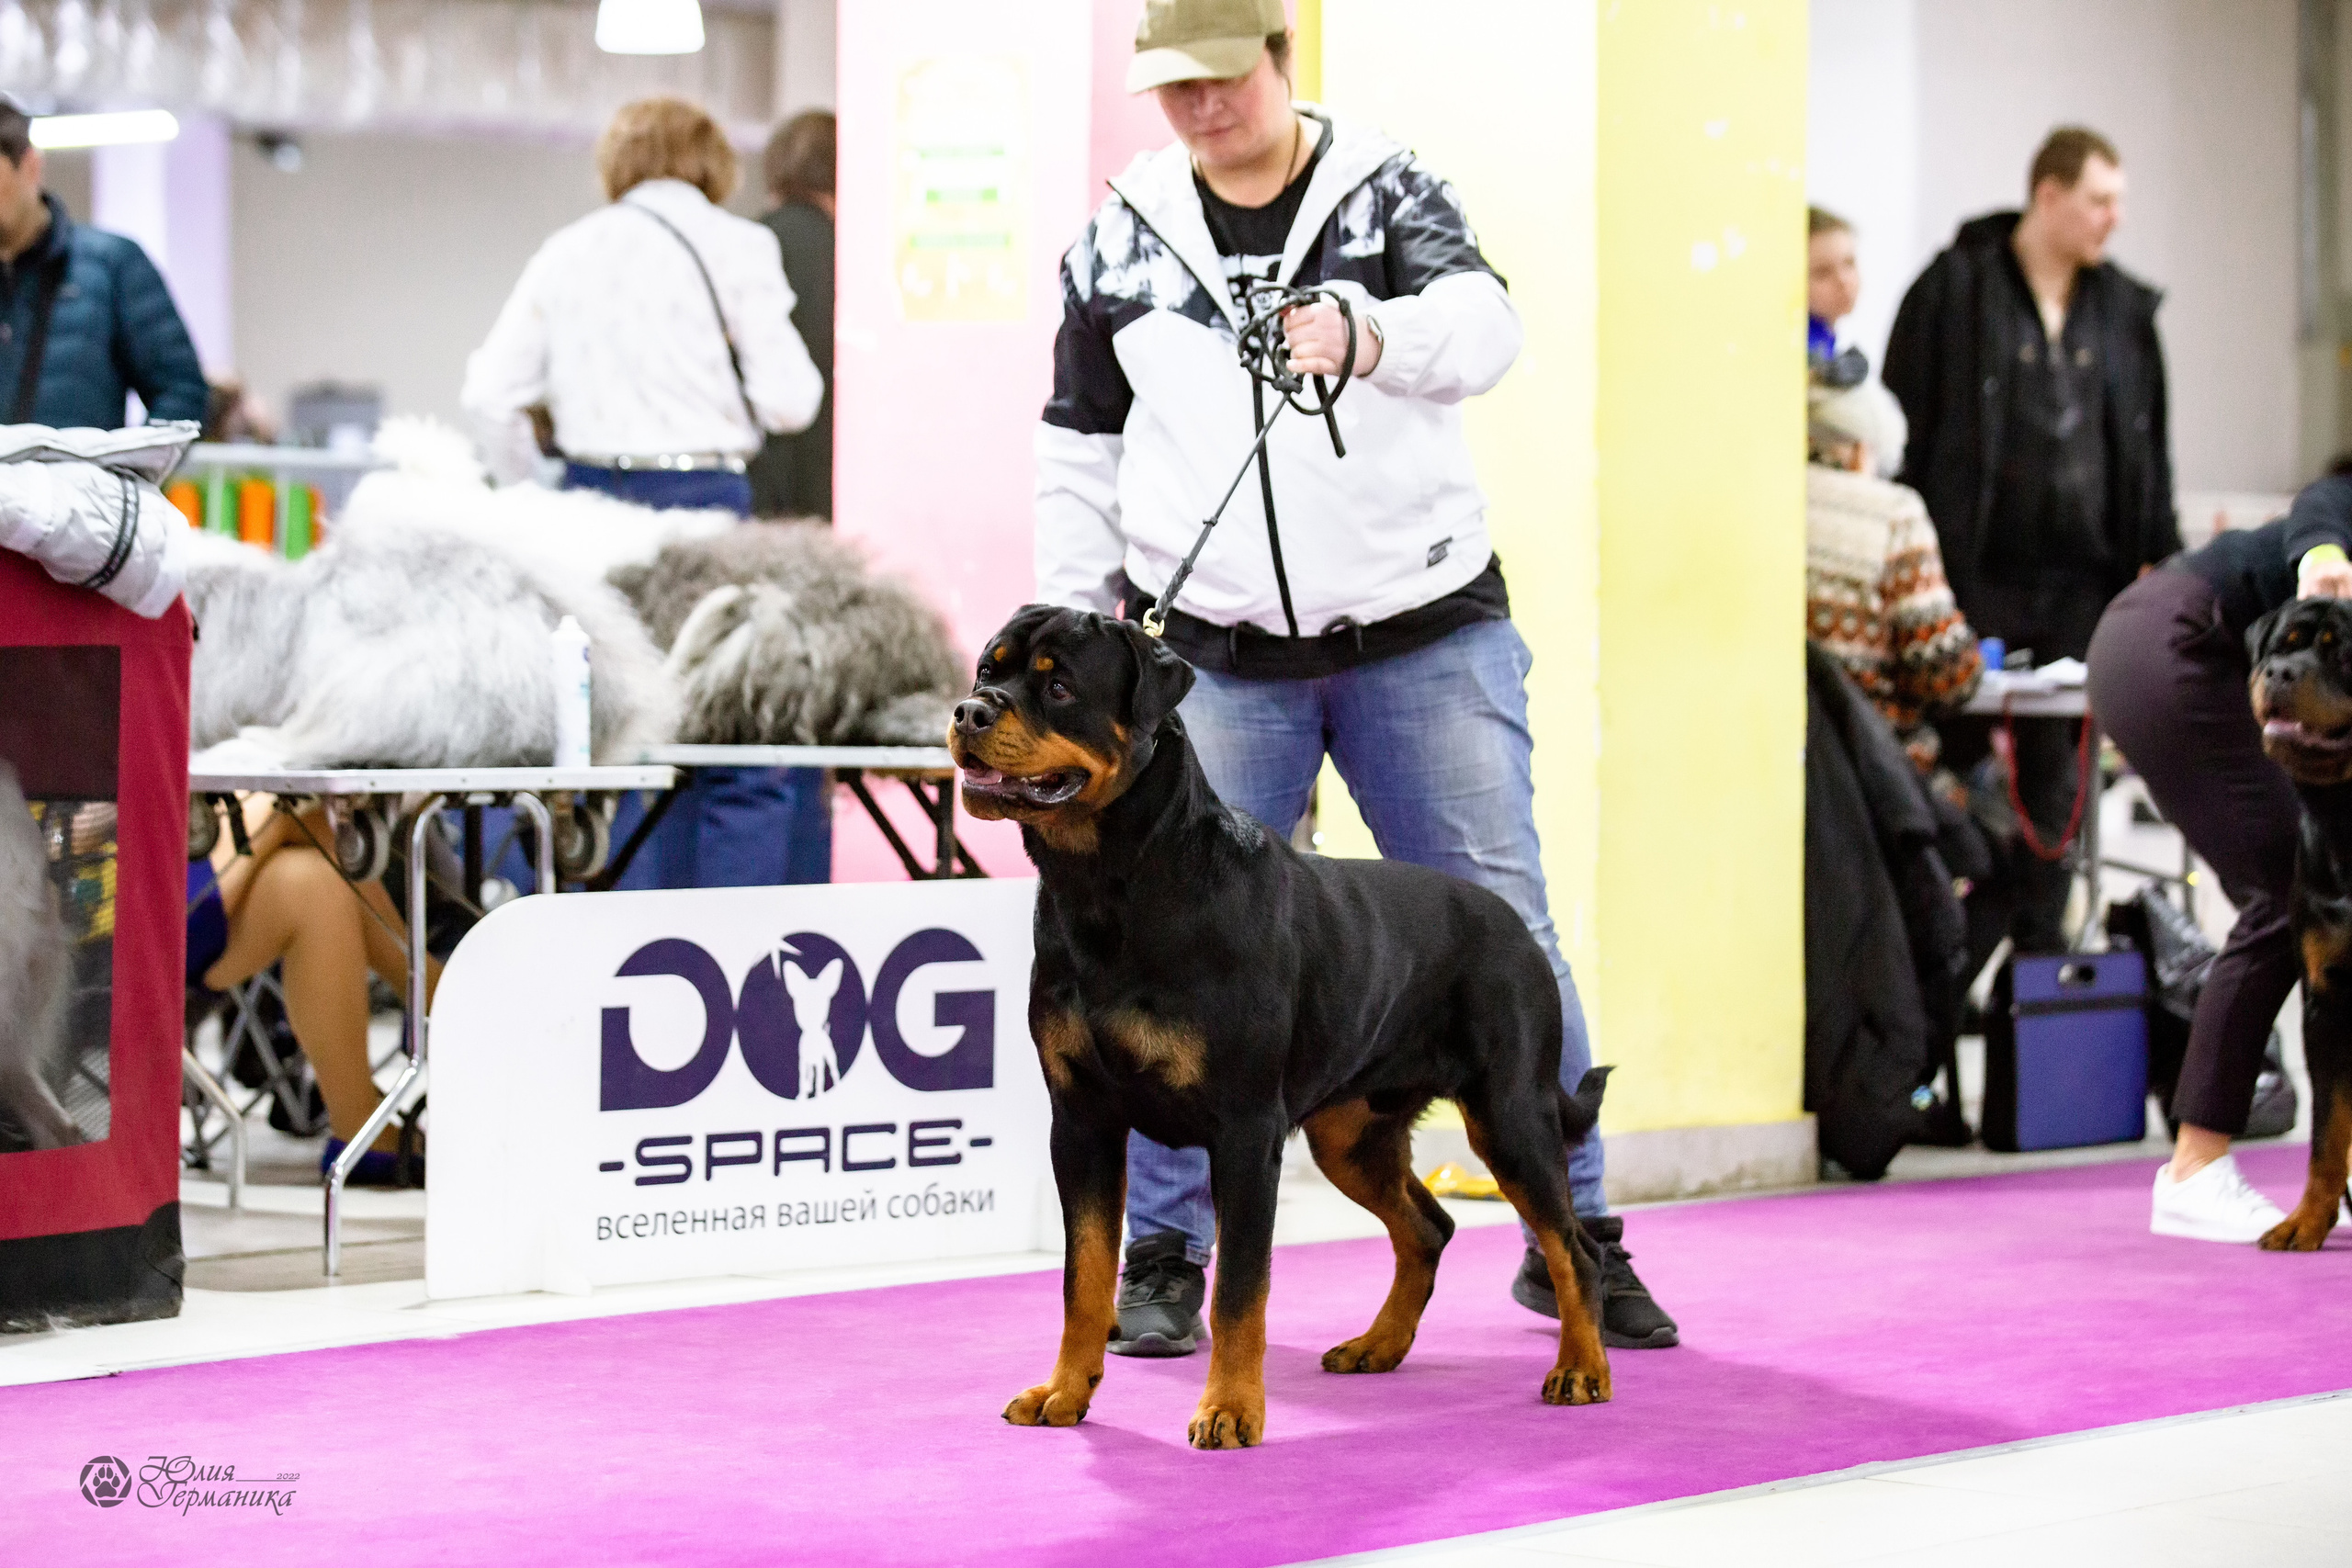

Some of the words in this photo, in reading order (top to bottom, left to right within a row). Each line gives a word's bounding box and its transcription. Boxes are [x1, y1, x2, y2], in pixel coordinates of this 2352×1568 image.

[599, 927, 996, 1111] DOG
[596, 1204, 767, 1241] вселенная
[777, 1190, 877, 1228] вашей
[887, 1183, 995, 1220] собаки
